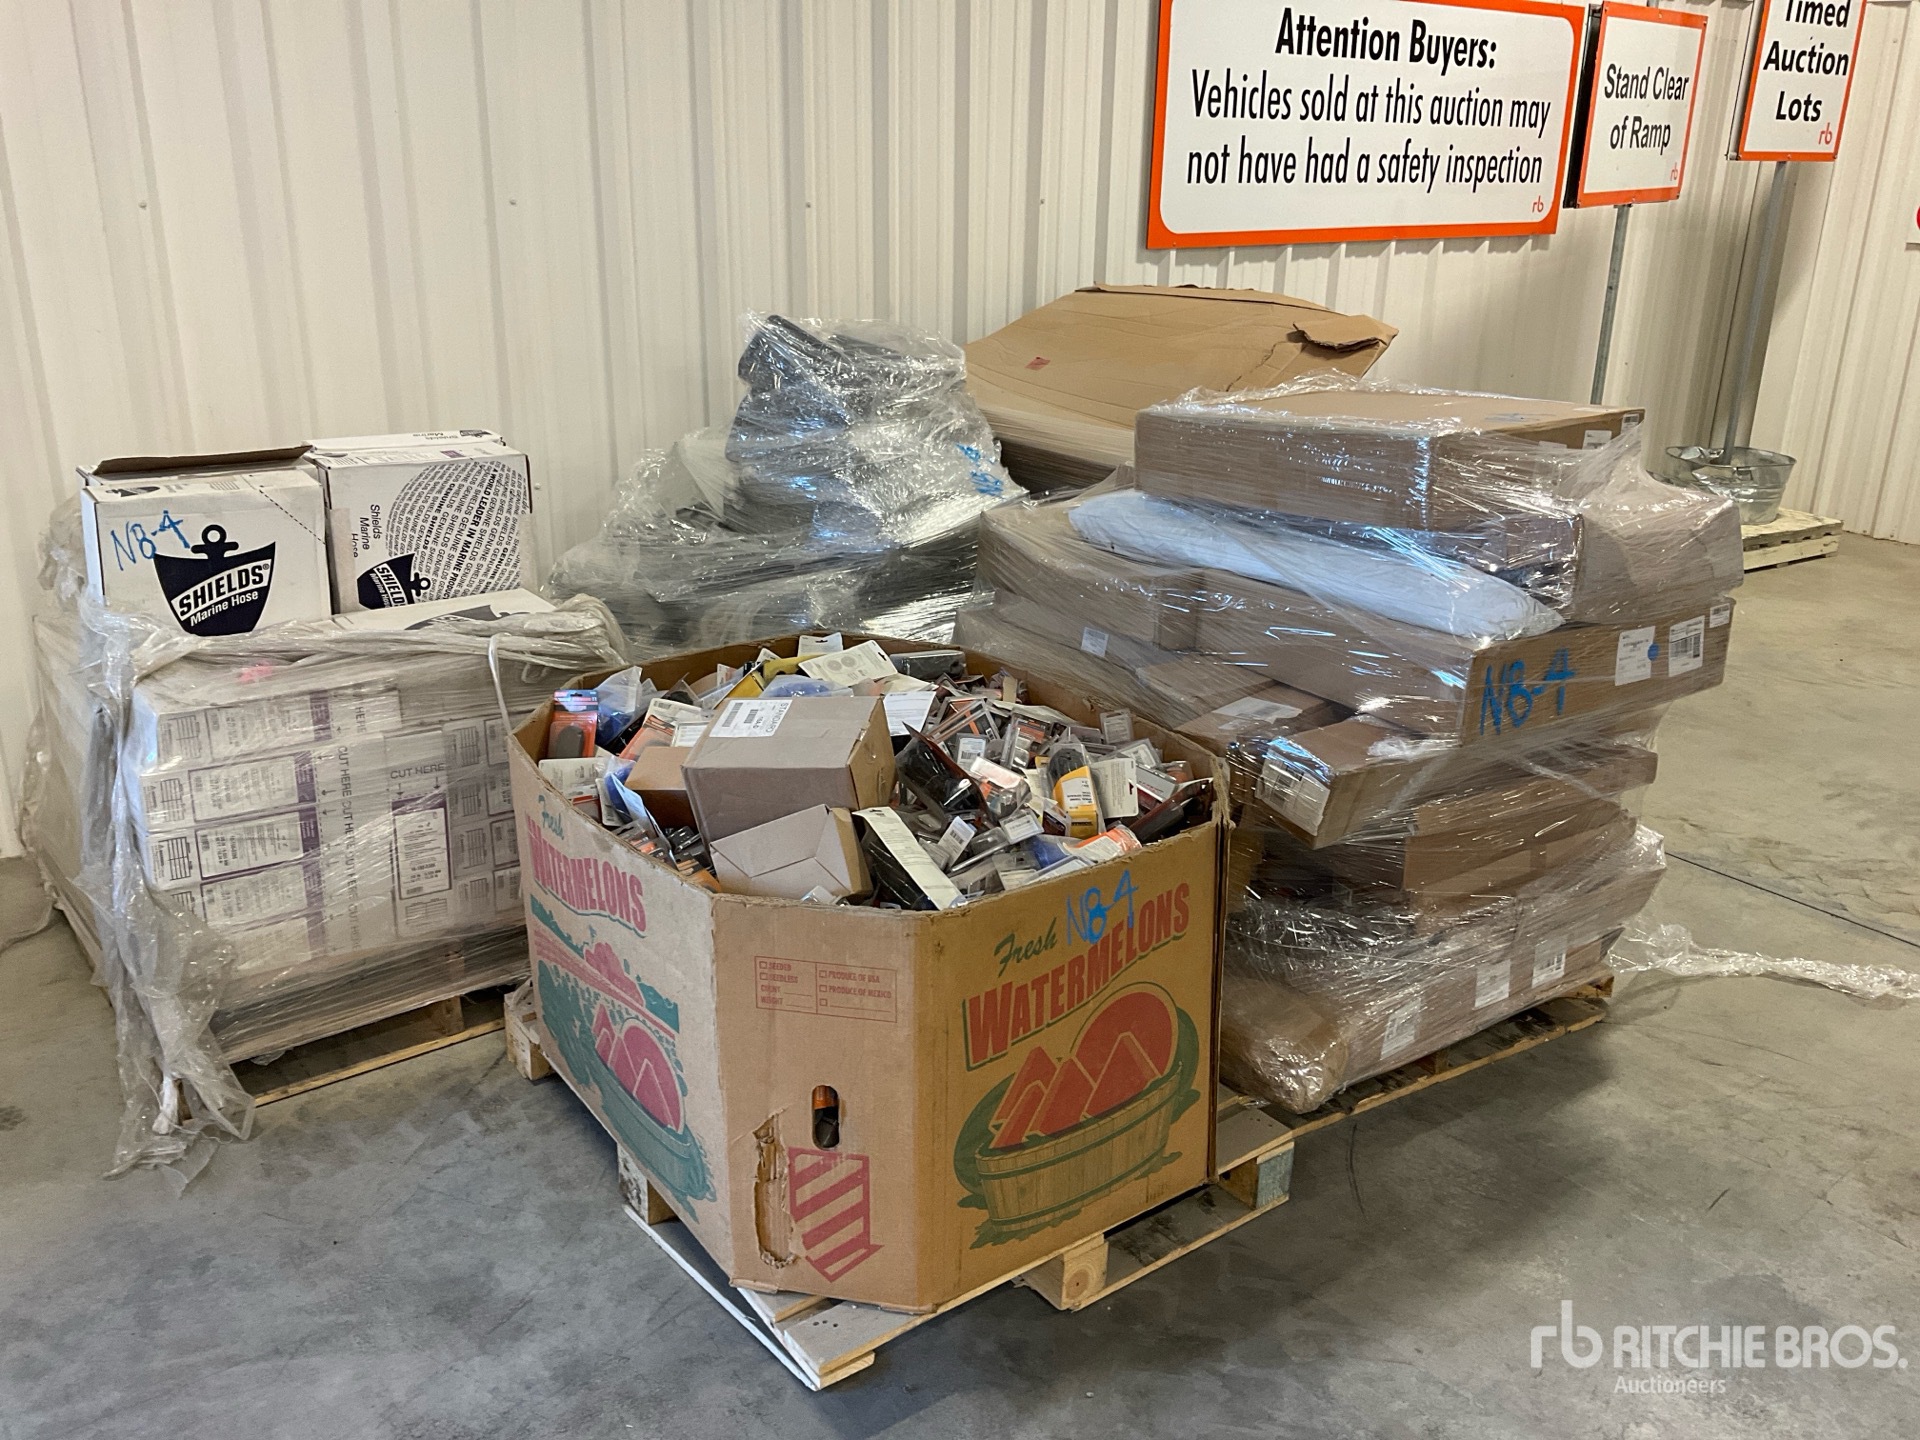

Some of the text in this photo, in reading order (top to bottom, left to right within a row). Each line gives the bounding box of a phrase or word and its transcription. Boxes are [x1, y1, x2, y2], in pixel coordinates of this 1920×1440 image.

[1785, 0, 1851, 27] Timed
[1275, 8, 1497, 76] Attention Buyers:
[1763, 41, 1849, 76] Auction
[1605, 63, 1689, 100] Stand Clear
[1192, 68, 1551, 138] Vehicles sold at this auction may
[1776, 91, 1822, 121] Lots
[1610, 116, 1671, 155] of Ramp
[1187, 135, 1542, 193] not have had a safety inspection
[484, 474, 496, 496] WORLD
[370, 504, 381, 539] Shields
[470, 496, 489, 526] LEADER
[360, 517, 370, 550] Marine
[441, 514, 458, 548] SHIELDS
[449, 517, 469, 552] GENUINE
[466, 528, 476, 538] IN
[469, 528, 487, 561] SHIELDS
[453, 540, 472, 572] MARINE
[489, 548, 508, 580] GENUINE
[377, 567, 407, 606] SHIELD
[190, 590, 259, 627] Marine Hose
[338, 746, 351, 797] CUT HERE
[390, 761, 446, 780] CUT HERE
[527, 813, 647, 933] WATERMELONS
[994, 916, 1057, 978] Fresh
[969, 882, 1189, 1065] WATERMELONS
